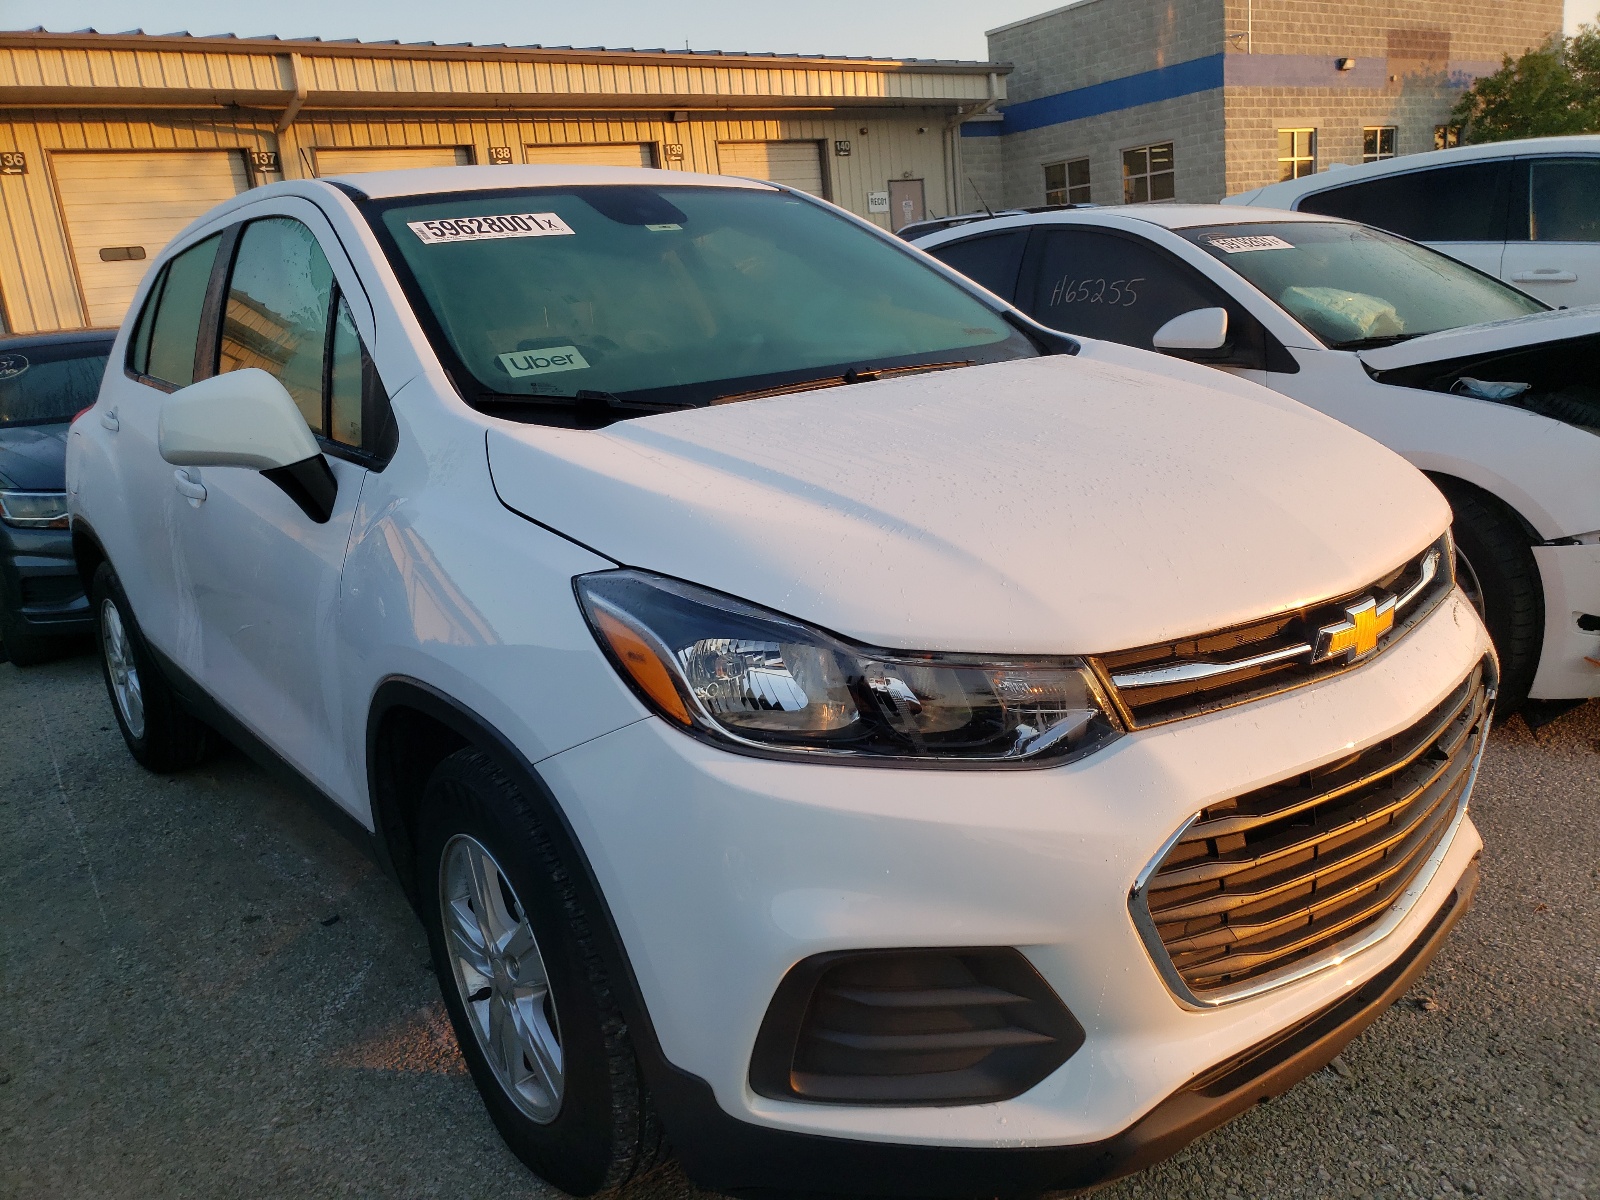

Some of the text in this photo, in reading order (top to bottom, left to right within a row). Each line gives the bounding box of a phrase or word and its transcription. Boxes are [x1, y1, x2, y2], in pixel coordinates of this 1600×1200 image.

[665, 144, 683, 155] 139
[836, 142, 850, 150] 140
[251, 152, 276, 165] 137
[490, 147, 511, 159] 138
[424, 214, 546, 238] 59628001
[1050, 274, 1145, 306] H65255
[509, 353, 574, 371] Uber
